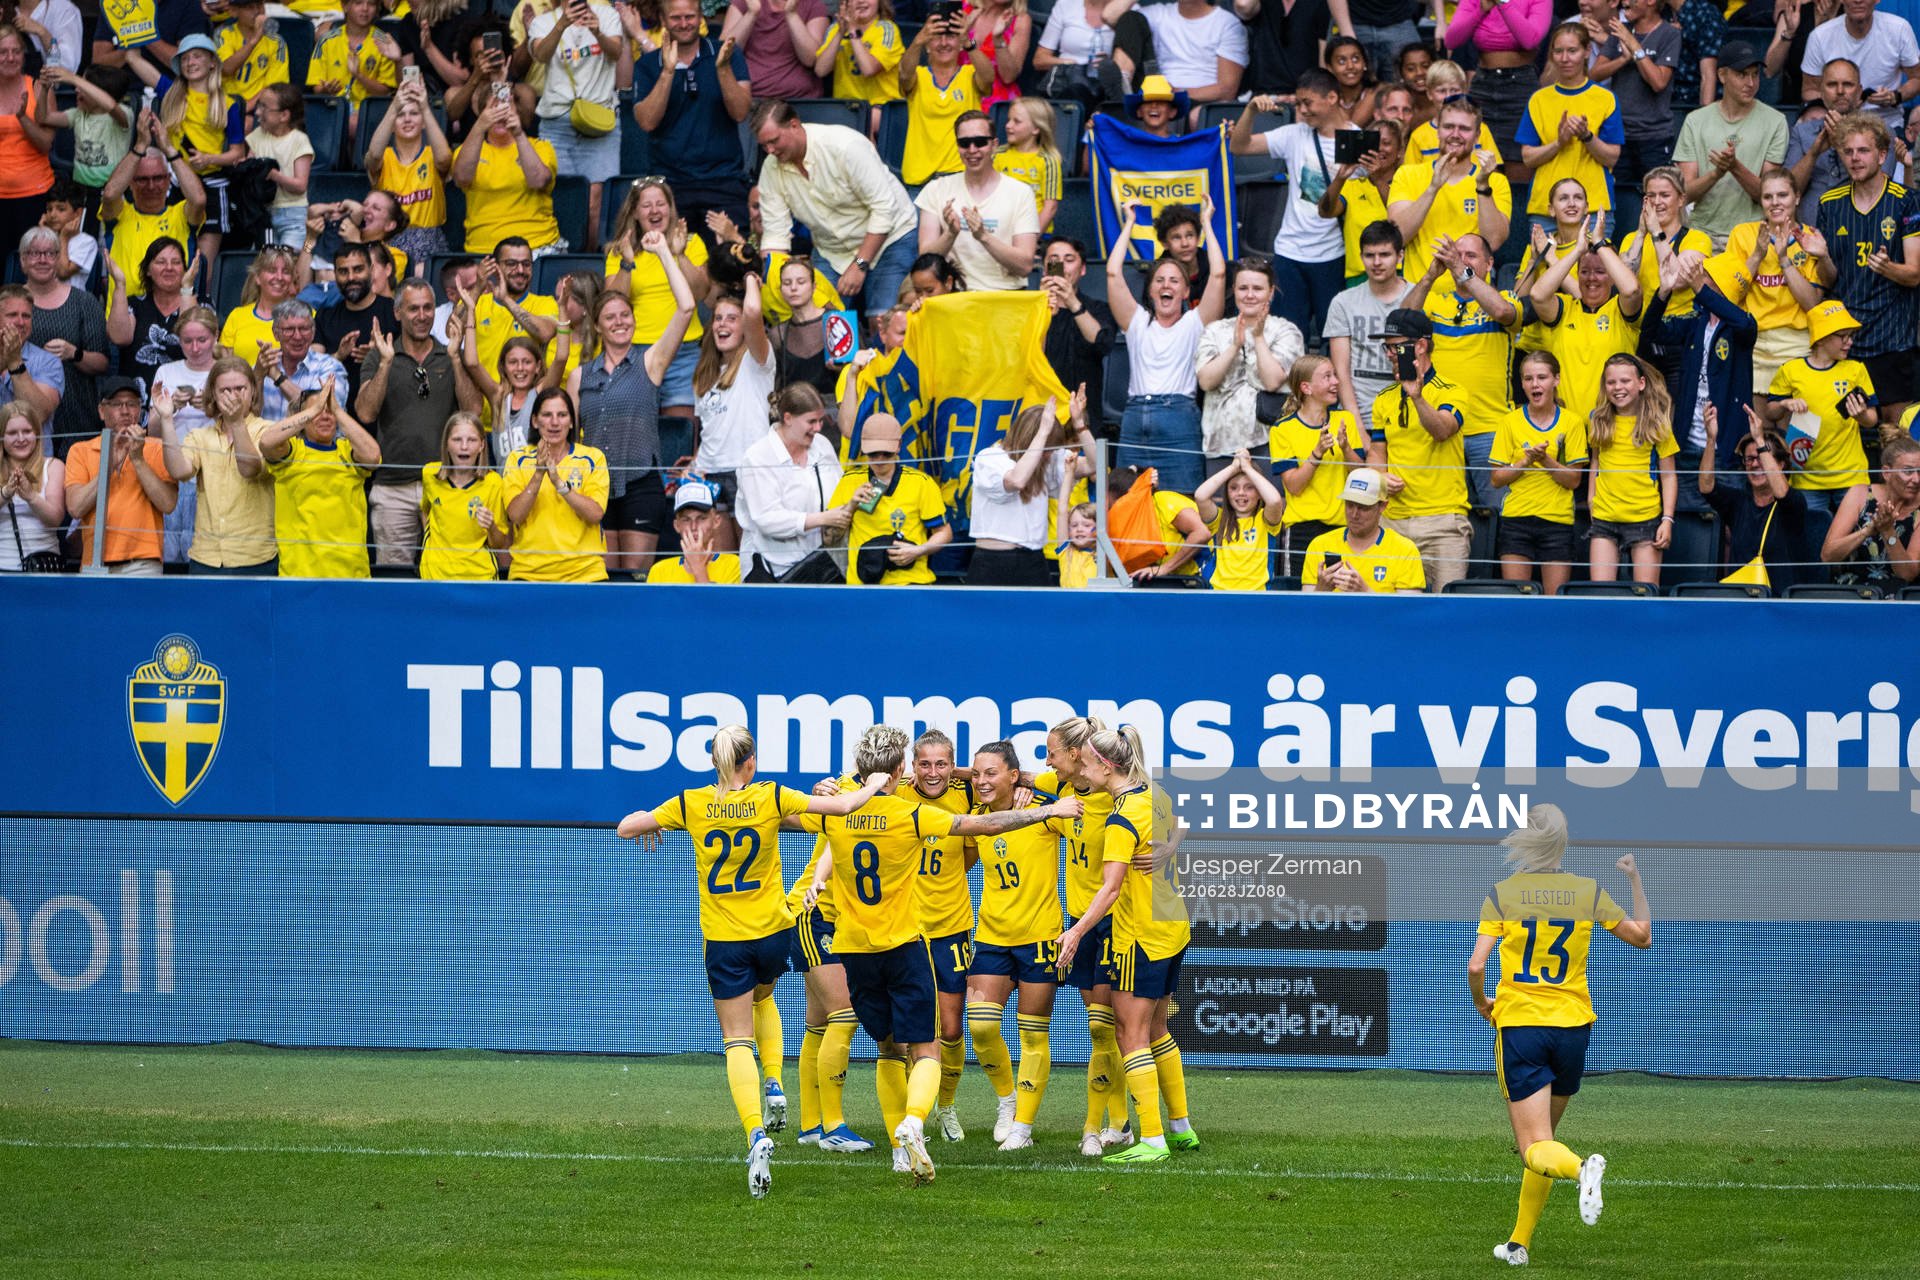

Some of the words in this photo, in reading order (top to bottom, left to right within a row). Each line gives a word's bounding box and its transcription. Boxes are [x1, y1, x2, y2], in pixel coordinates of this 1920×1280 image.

[1122, 183, 1196, 199] SVERIGE
[159, 686, 196, 697] SvFF
[1258, 673, 1396, 783] är
[1418, 675, 1538, 786] vi
[1565, 681, 1920, 814] Sveri
[706, 802, 757, 819] SCHOUGH
[846, 815, 887, 831] HURTIG
[704, 828, 761, 895] 22
[918, 847, 943, 876] 16
[1070, 838, 1089, 869] 14
[853, 841, 883, 906] 8
[994, 861, 1020, 890] 19
[1521, 890, 1576, 906] ILESTEDT
[1190, 894, 1264, 936] App
[1271, 894, 1368, 931] Store
[950, 942, 971, 972] 16
[1034, 940, 1057, 963] 19
[1513, 916, 1575, 984] 13
[1194, 977, 1251, 995] LADDA
[1255, 978, 1291, 995] NED
[1293, 976, 1317, 997] PÅ
[1195, 999, 1305, 1045] Google
[1309, 1003, 1374, 1046] Play
